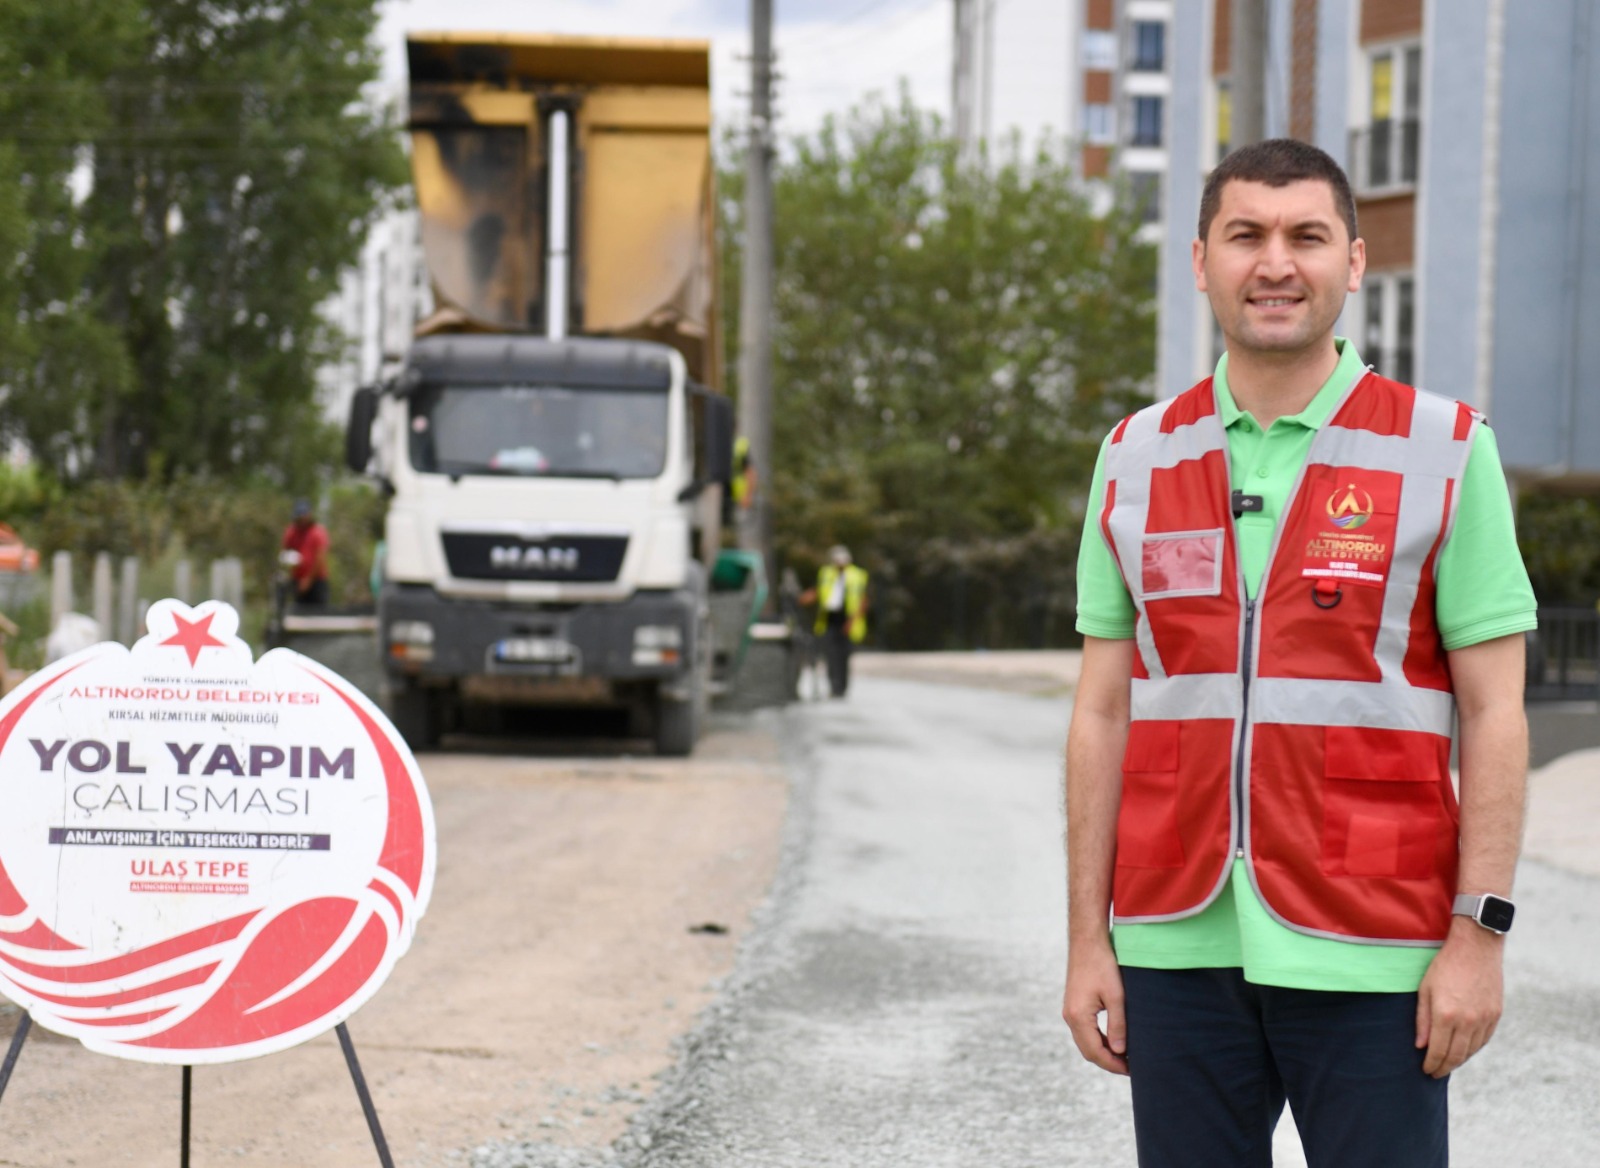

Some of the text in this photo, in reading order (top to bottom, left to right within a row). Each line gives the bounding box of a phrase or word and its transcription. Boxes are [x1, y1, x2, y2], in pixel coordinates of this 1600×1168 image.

[491, 546, 579, 570] MAN
[69, 686, 320, 704] ALTINORDU BELEDİYESİ
[108, 709, 145, 720] KIRSAL
[149, 708, 207, 722] HİZMETLER
[28, 739, 355, 779] YOL YAPIM
[73, 782, 310, 821] ÇALIŞMASI
[65, 829, 311, 850] ANLAYIŞINIZ İÇİN TEŞEKKÜR EDERİZ
[130, 859, 249, 882] ULAŞ TEPE
